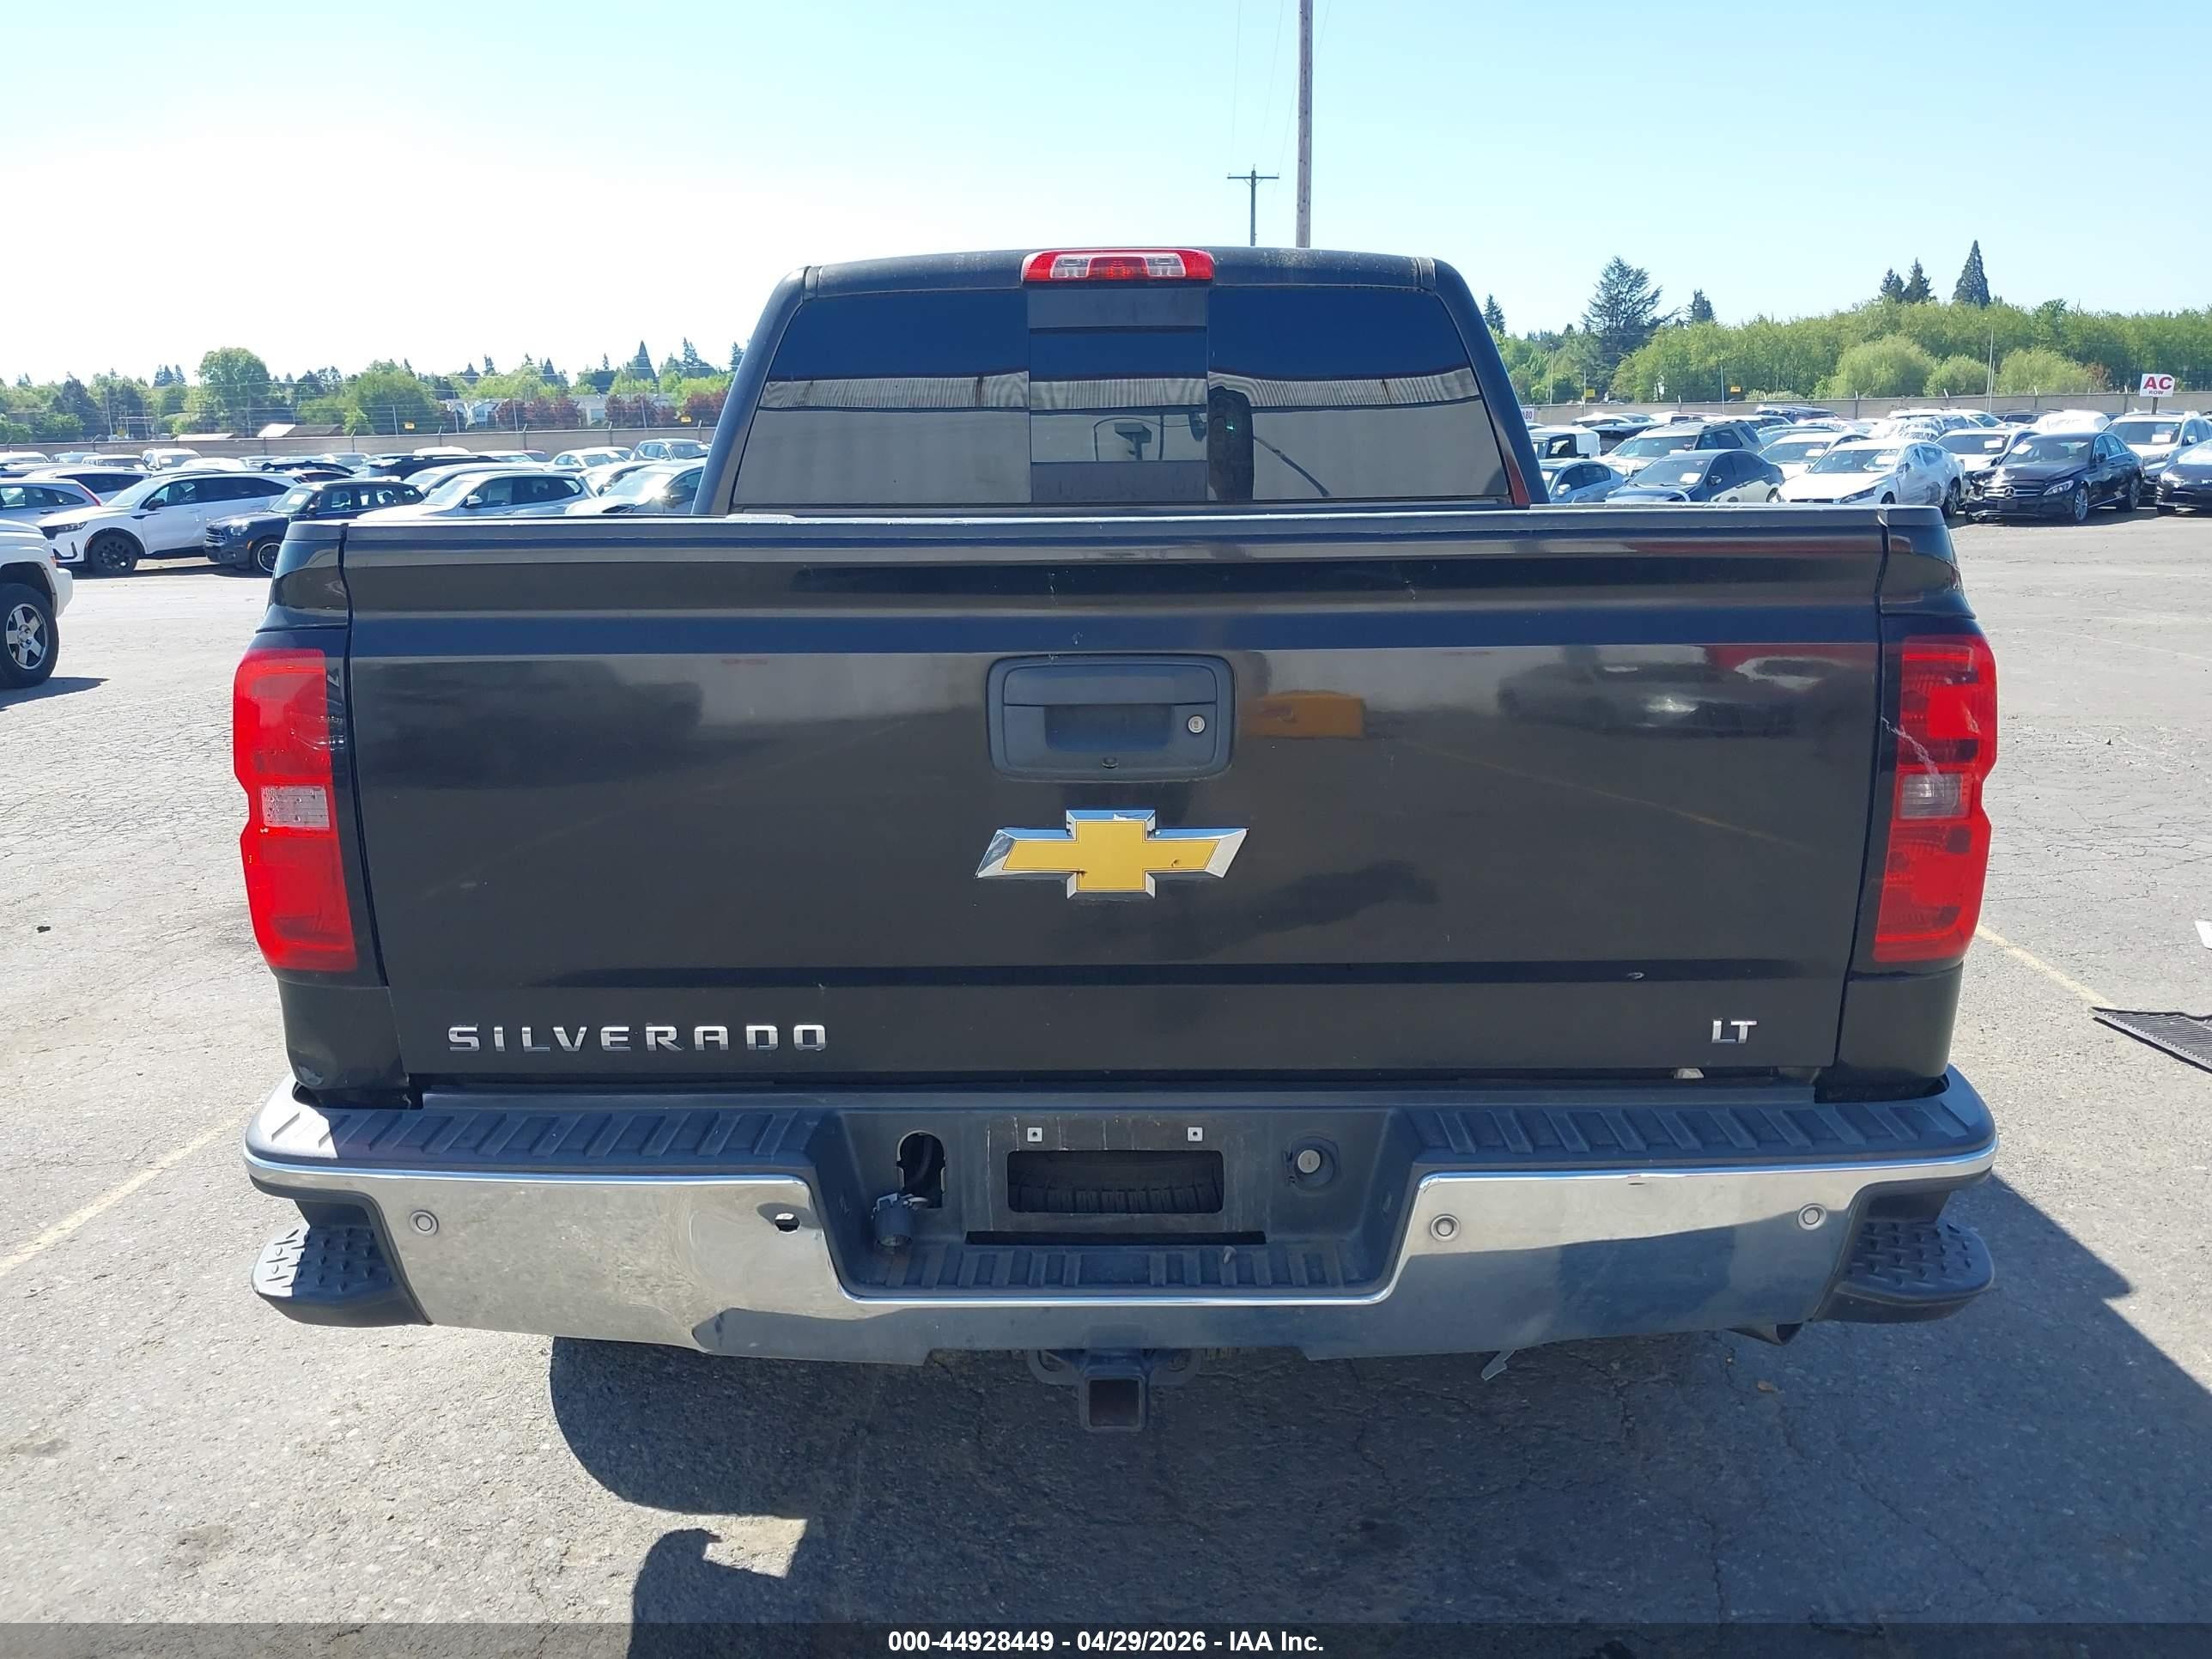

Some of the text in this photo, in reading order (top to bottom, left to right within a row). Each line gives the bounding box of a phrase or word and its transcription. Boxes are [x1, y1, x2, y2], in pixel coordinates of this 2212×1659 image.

[2143, 376, 2172, 390] AC
[448, 1024, 826, 1052] SILVERADO
[1711, 1019, 1758, 1044] LT
